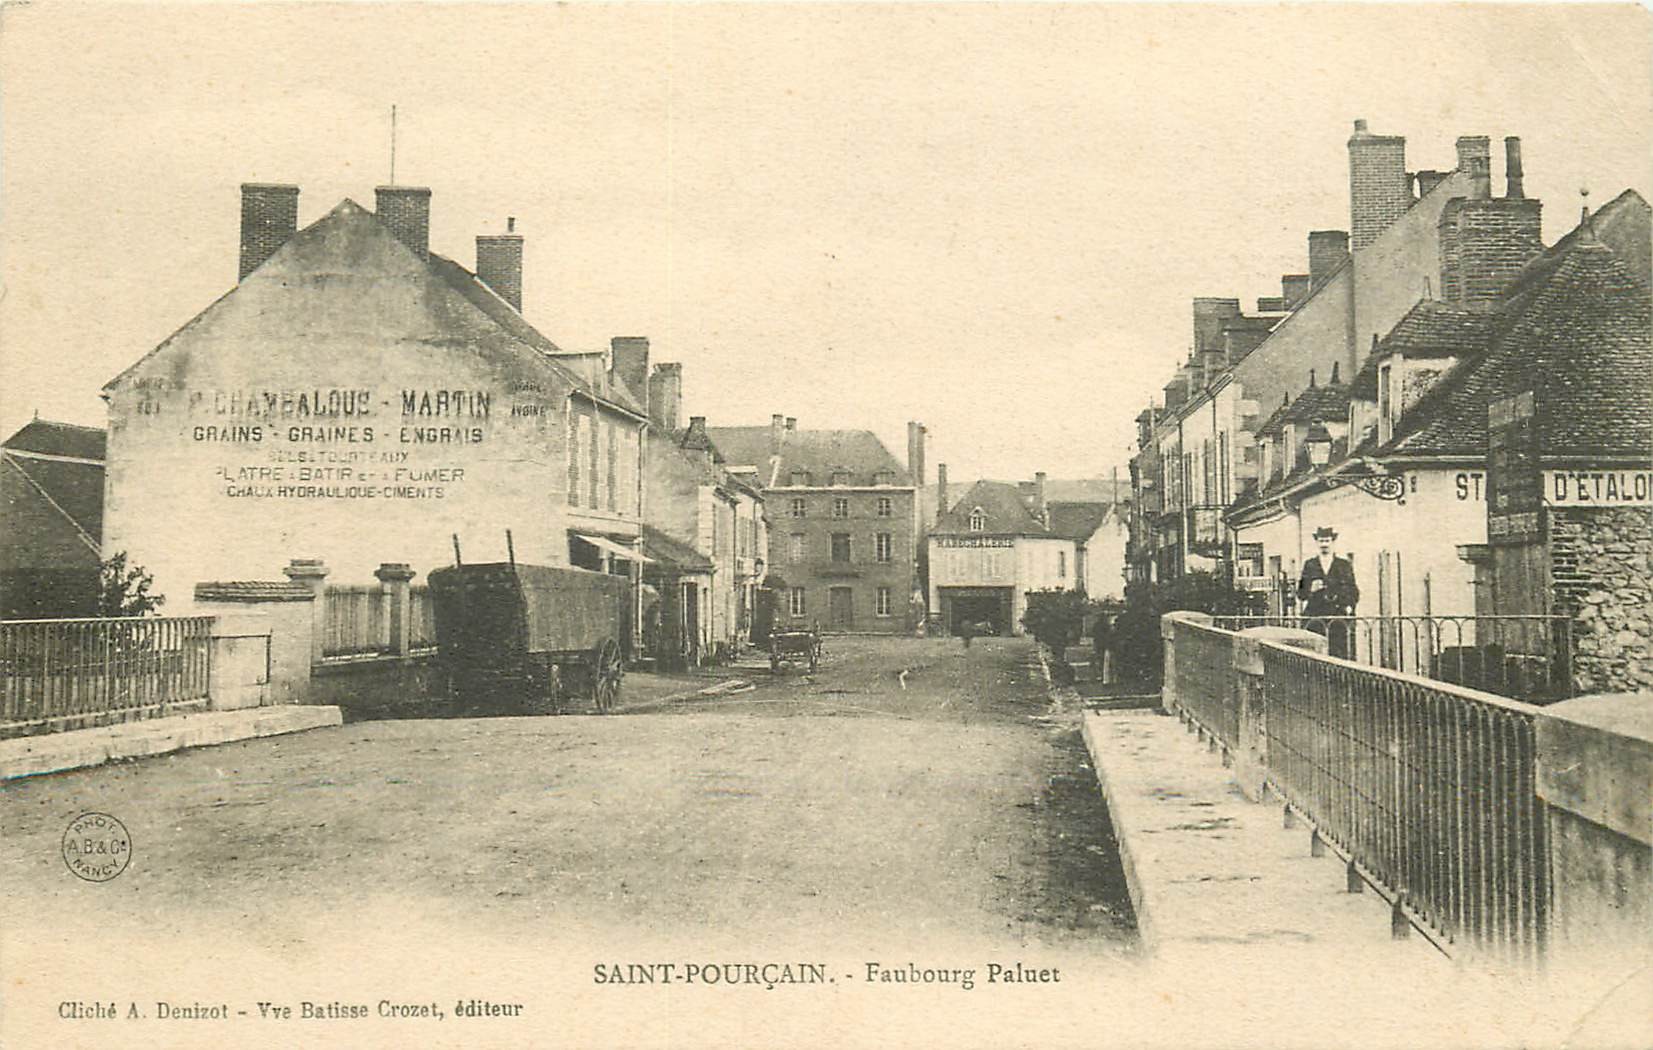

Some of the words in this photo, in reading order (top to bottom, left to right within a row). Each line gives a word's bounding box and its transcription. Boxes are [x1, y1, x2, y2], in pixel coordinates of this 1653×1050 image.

[402, 390, 490, 418] MARTIN
[193, 426, 263, 443] GRAINS
[288, 426, 374, 443] GRAINES
[399, 426, 484, 444] ENGRAIS
[395, 468, 464, 482] FUMER
[1554, 473, 1653, 502] D'ETALO
